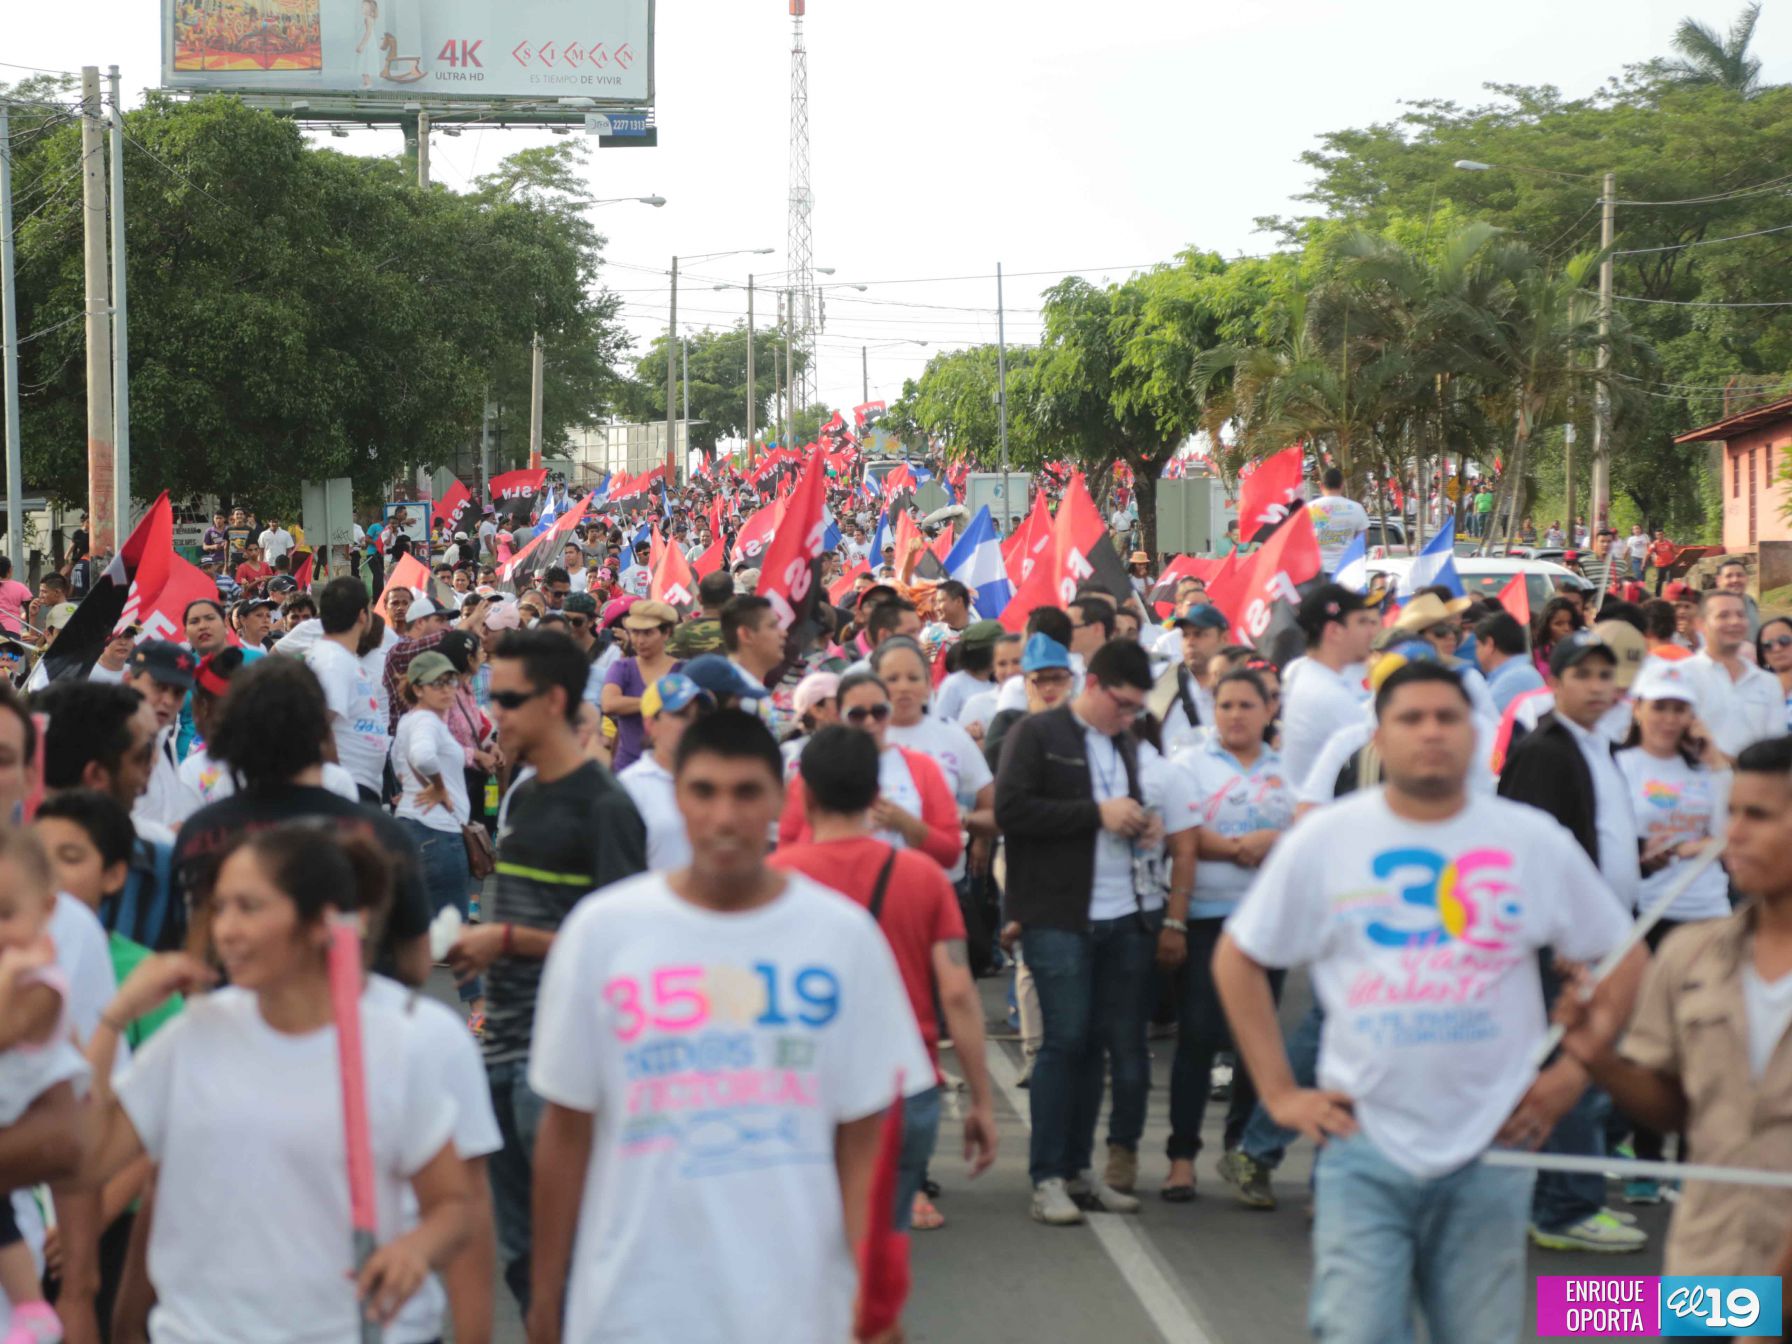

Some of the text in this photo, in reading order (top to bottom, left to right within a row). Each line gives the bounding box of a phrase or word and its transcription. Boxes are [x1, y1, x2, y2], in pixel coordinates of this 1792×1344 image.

[437, 39, 484, 68] 4K
[435, 71, 485, 82] ULTRA HD
[529, 74, 622, 86] ES TIEMPO DE VIVIR
[612, 119, 628, 131] 2277
[630, 119, 646, 131] 1313
[603, 960, 842, 1043] 35 19
